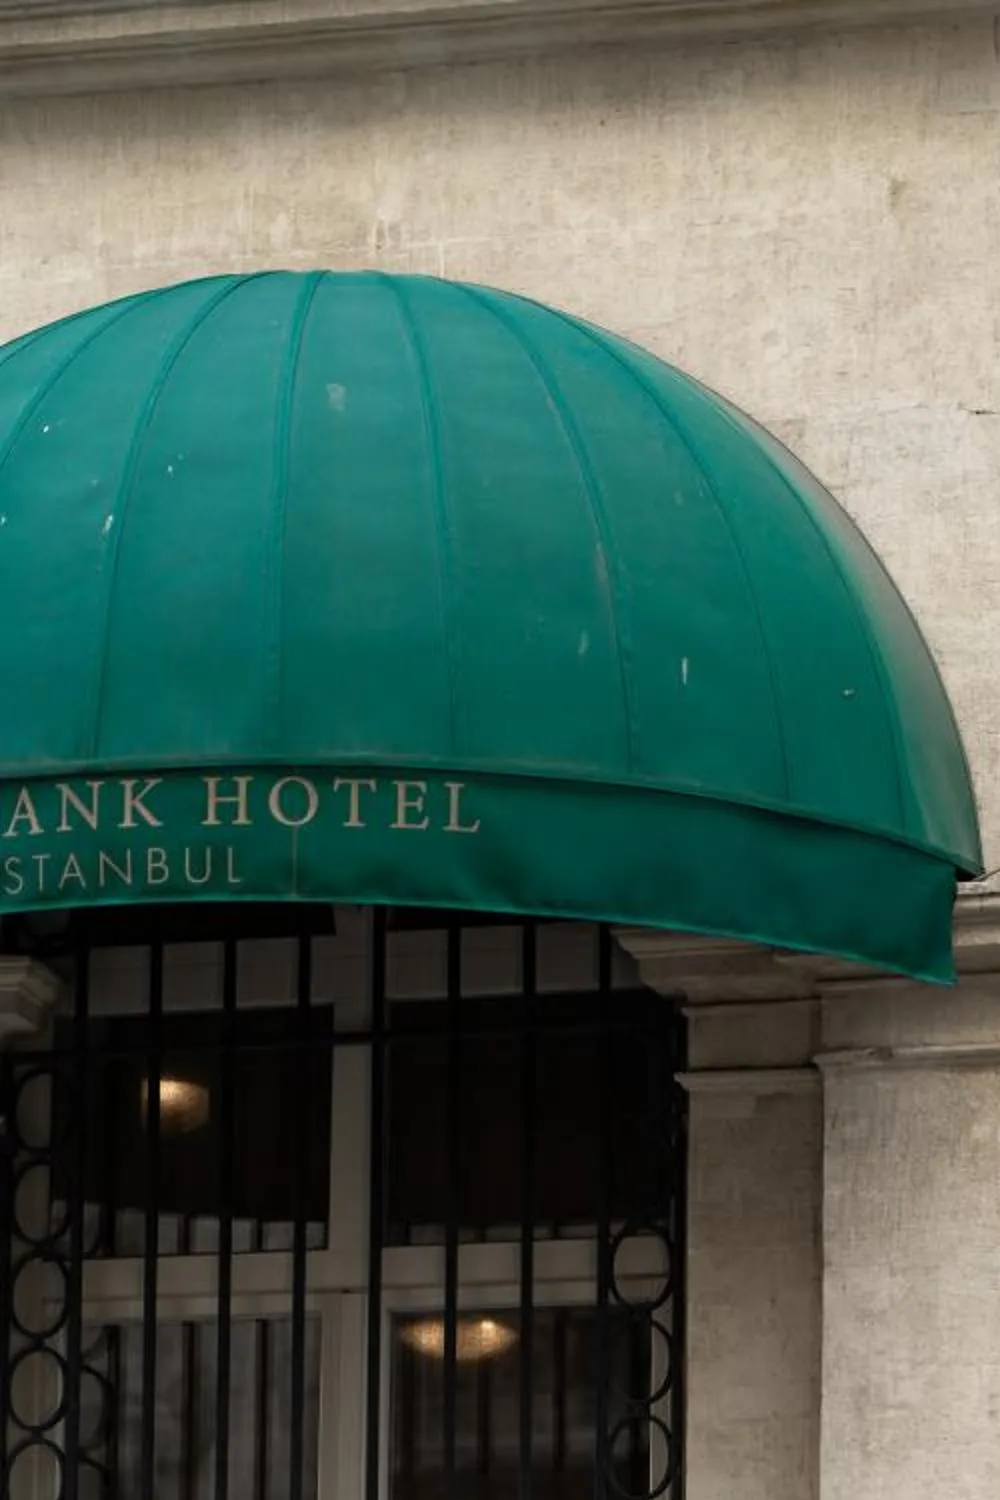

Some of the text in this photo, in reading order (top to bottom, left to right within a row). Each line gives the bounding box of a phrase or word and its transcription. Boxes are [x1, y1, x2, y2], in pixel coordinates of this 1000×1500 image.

[1, 775, 481, 838] ANK HOTEL
[4, 846, 243, 896] STANBUL
